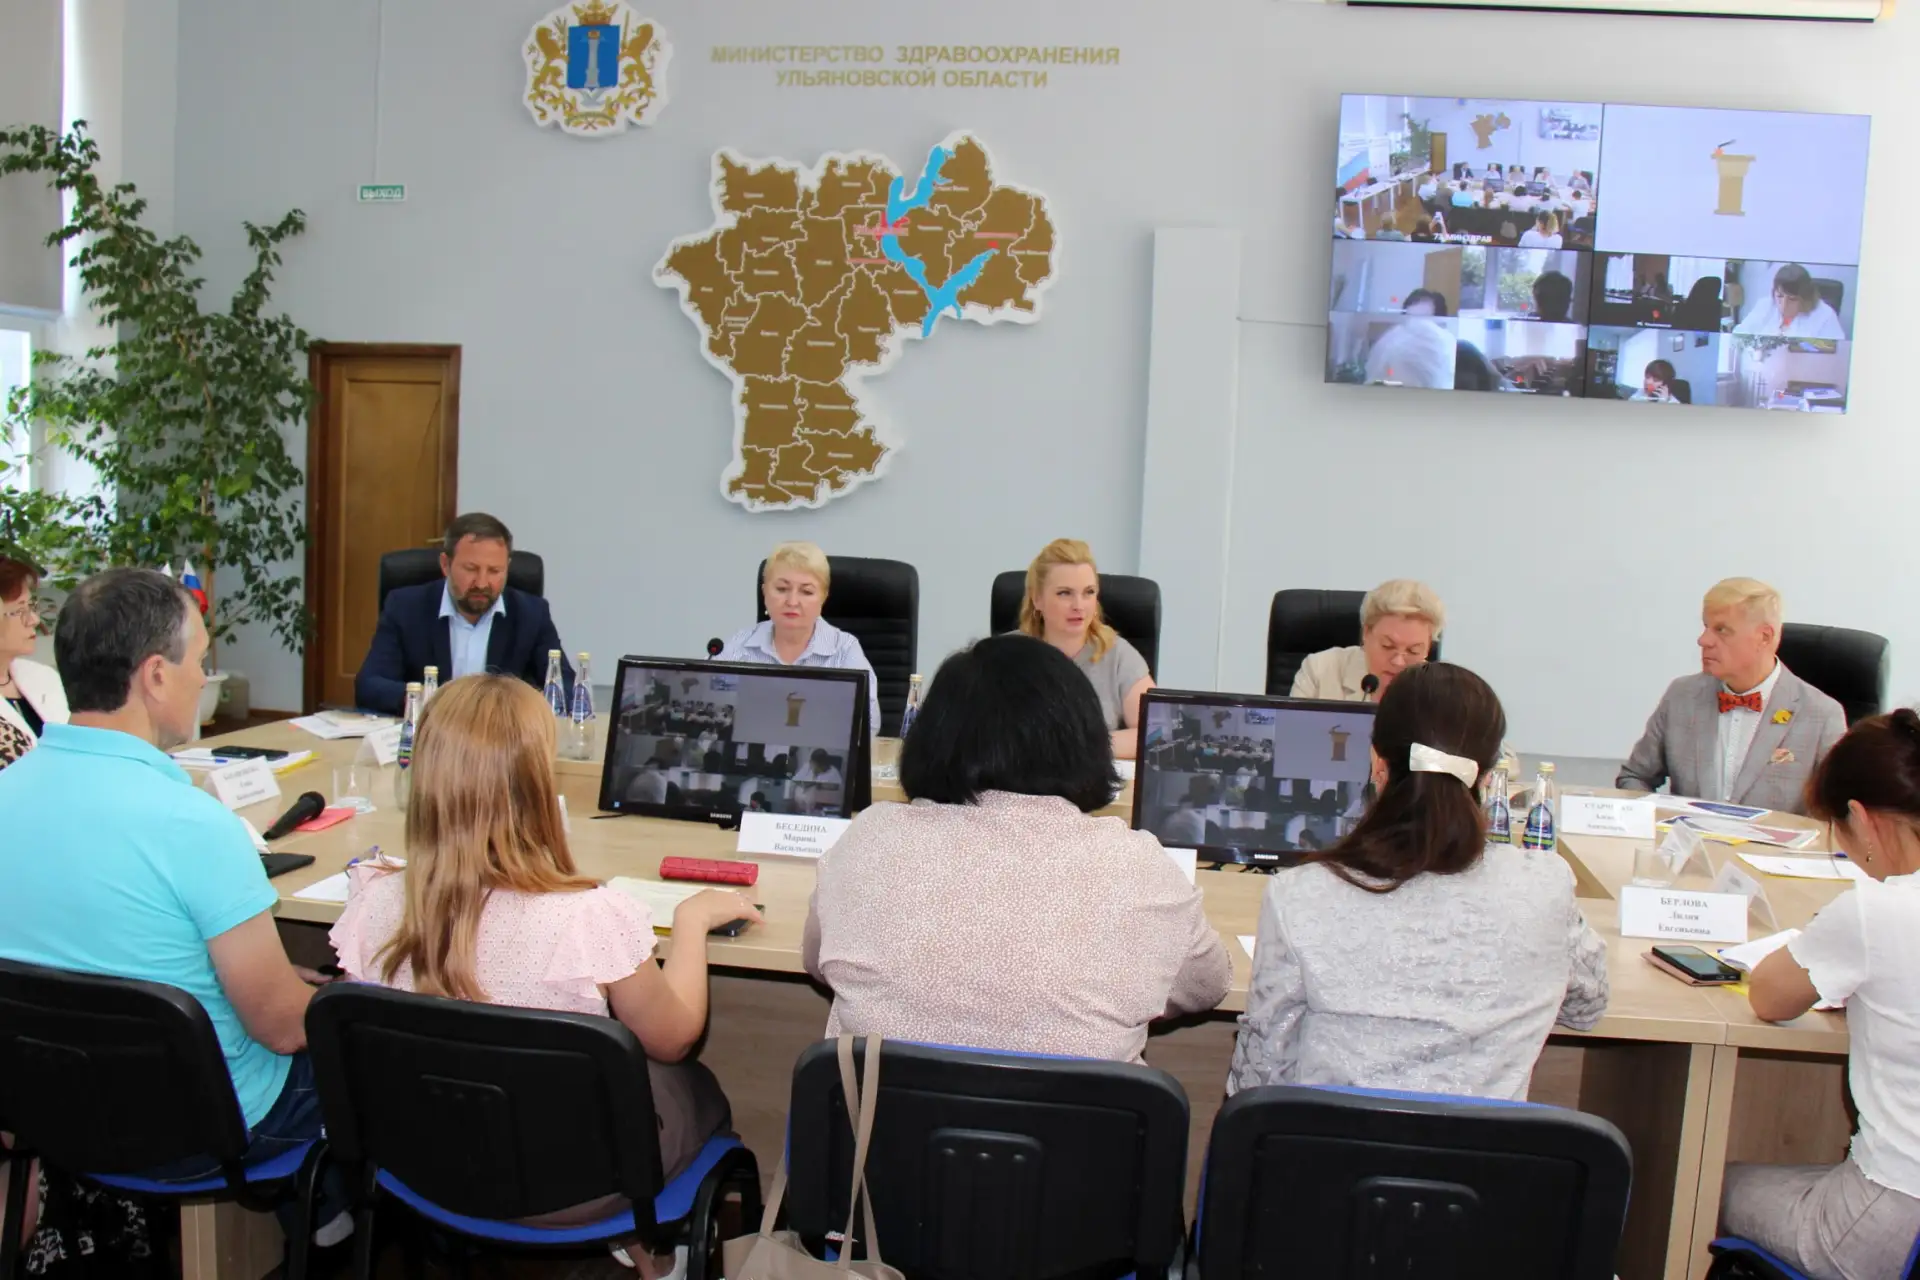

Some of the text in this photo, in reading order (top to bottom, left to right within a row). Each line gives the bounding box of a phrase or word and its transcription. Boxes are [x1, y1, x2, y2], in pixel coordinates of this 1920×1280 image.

[711, 45, 1120, 65] МИНИСТЕРСТВО ЗДРАВООХРАНЕНИЯ
[775, 66, 1048, 88] УЛЬЯНОВСКОЙ ОБЛАСТИ
[775, 822, 828, 834] БЕСЕДИНА
[783, 833, 817, 844] Марина
[1660, 896, 1708, 909] БЕРЛОВА
